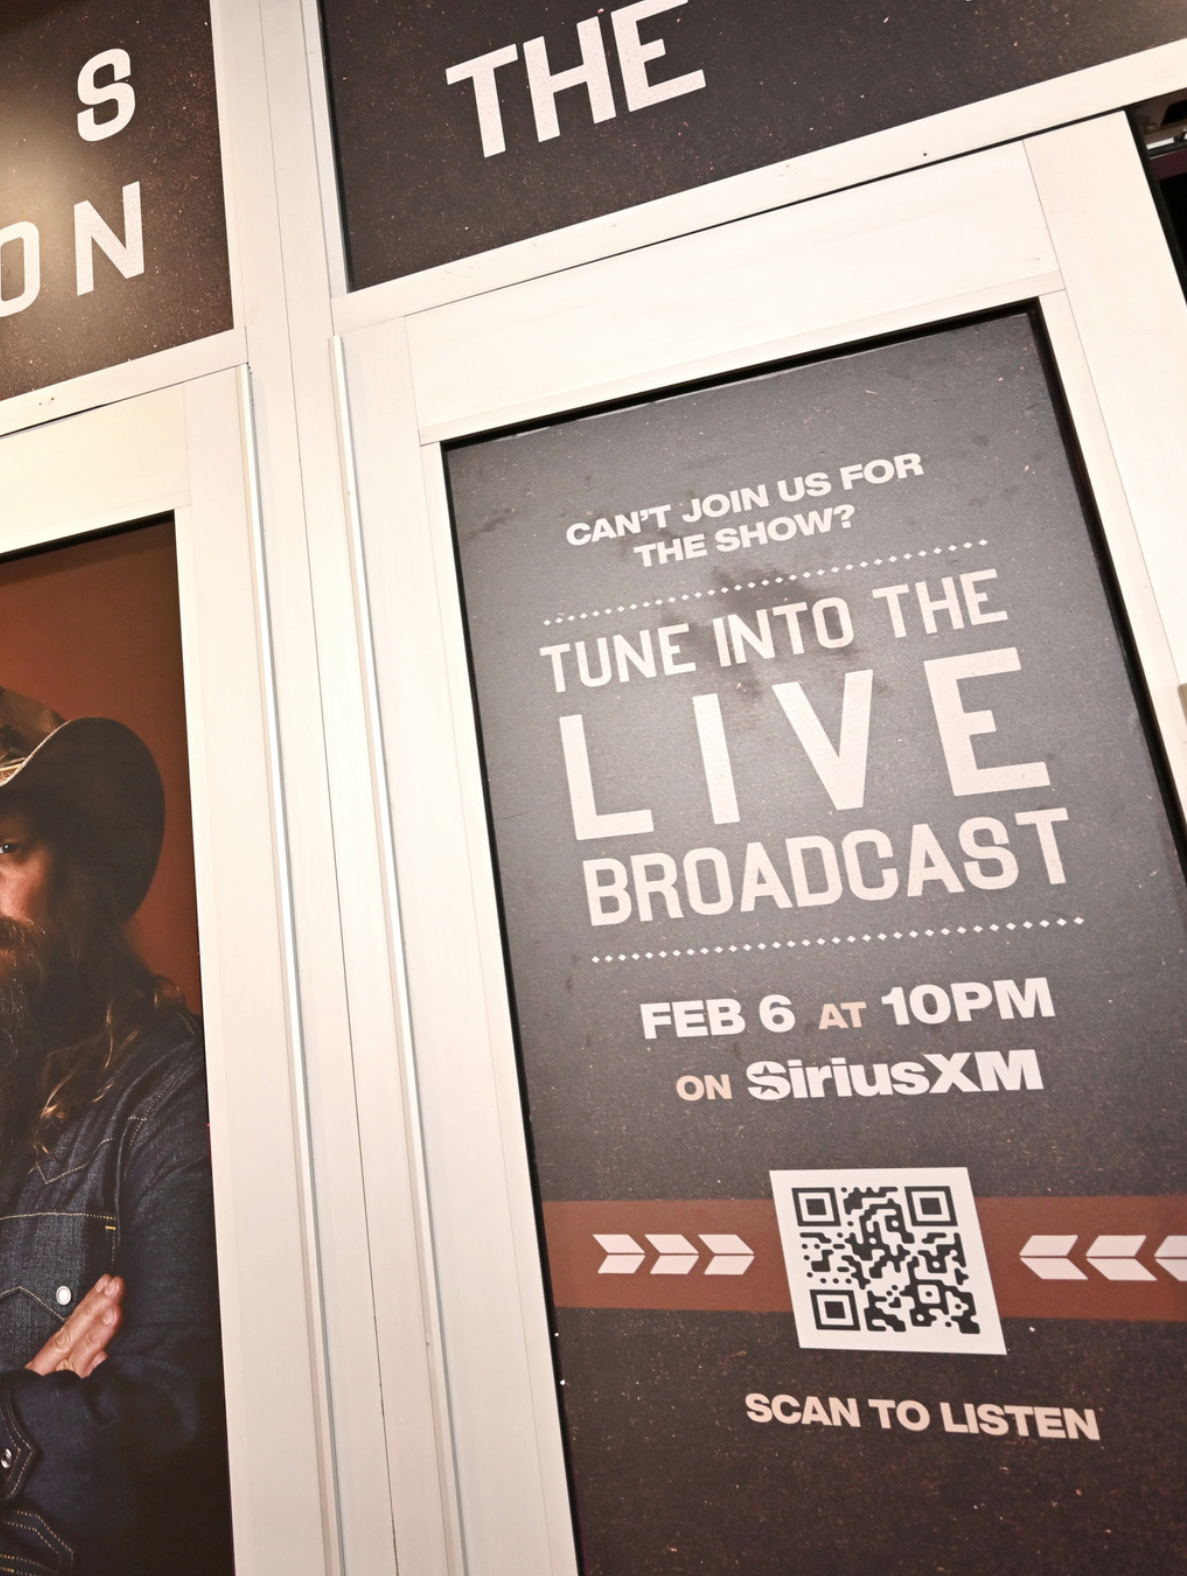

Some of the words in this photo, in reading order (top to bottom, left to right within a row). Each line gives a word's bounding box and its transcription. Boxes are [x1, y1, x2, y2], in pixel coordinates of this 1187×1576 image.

[445, 0, 706, 158] THE
[566, 505, 672, 546] CAN'T
[681, 483, 770, 522] JOIN
[777, 472, 832, 503] US
[839, 452, 924, 491] FOR
[634, 533, 707, 567] THE
[715, 503, 855, 552] SHOW?
[540, 623, 697, 693] TUNE
[712, 597, 854, 667] INTO
[872, 568, 1008, 639] THE
[559, 647, 1051, 840] LIVE
[582, 807, 1069, 927] BROADCAST
[640, 998, 746, 1039] FEB
[758, 994, 795, 1033] 6
[818, 1001, 867, 1030] AT
[881, 977, 1055, 1026] 10PM
[676, 1074, 732, 1101] ON
[747, 1049, 1044, 1101] SiriusXM
[745, 1393, 861, 1428] SCAN
[868, 1399, 930, 1431] TO
[939, 1402, 1101, 1441] LISTEN
